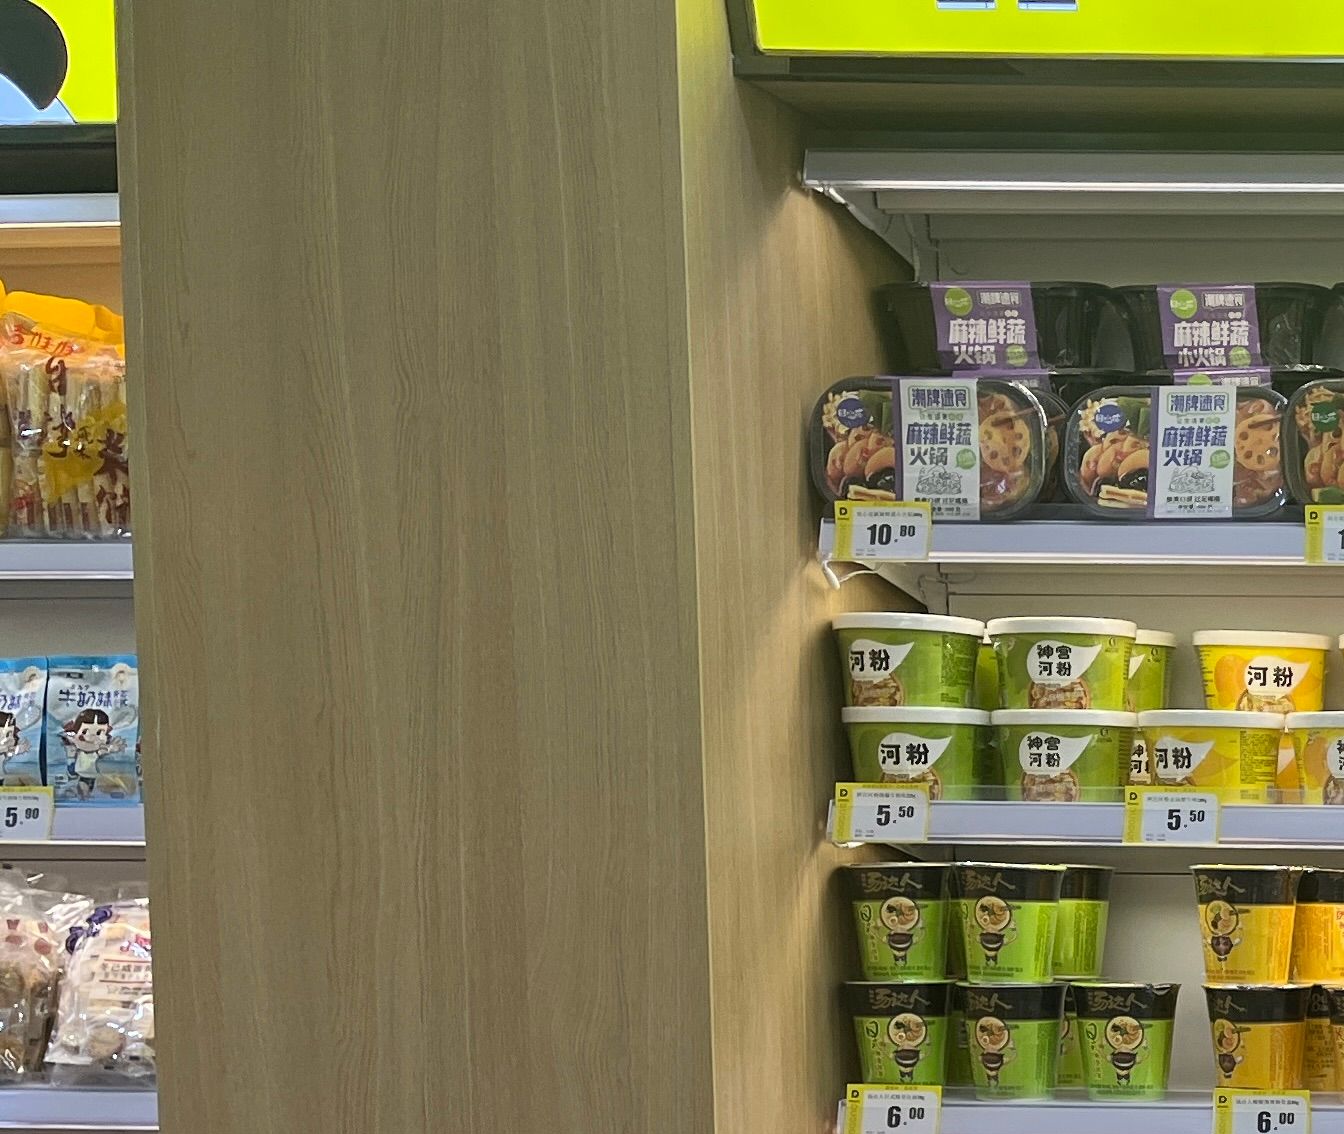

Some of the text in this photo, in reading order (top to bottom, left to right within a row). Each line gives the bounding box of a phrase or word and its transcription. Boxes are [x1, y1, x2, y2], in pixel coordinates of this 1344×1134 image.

[949, 318, 1026, 345] 麻辣鲜蔬
[953, 345, 996, 365] 火锅
[907, 422, 972, 446] 麻辣鲜蔬
[1162, 425, 1226, 449] 麻辣鲜蔬
[910, 447, 949, 467] 火锅
[1164, 449, 1202, 468] 火锅
[867, 523, 916, 546] 10.80
[1247, 665, 1294, 687] 河粉
[879, 743, 930, 767] 河粉
[876, 805, 914, 827] 5.50
[1167, 808, 1205, 831] 5.50
[887, 1105, 925, 1128] 6.00
[1257, 1111, 1295, 1134] 6.00
